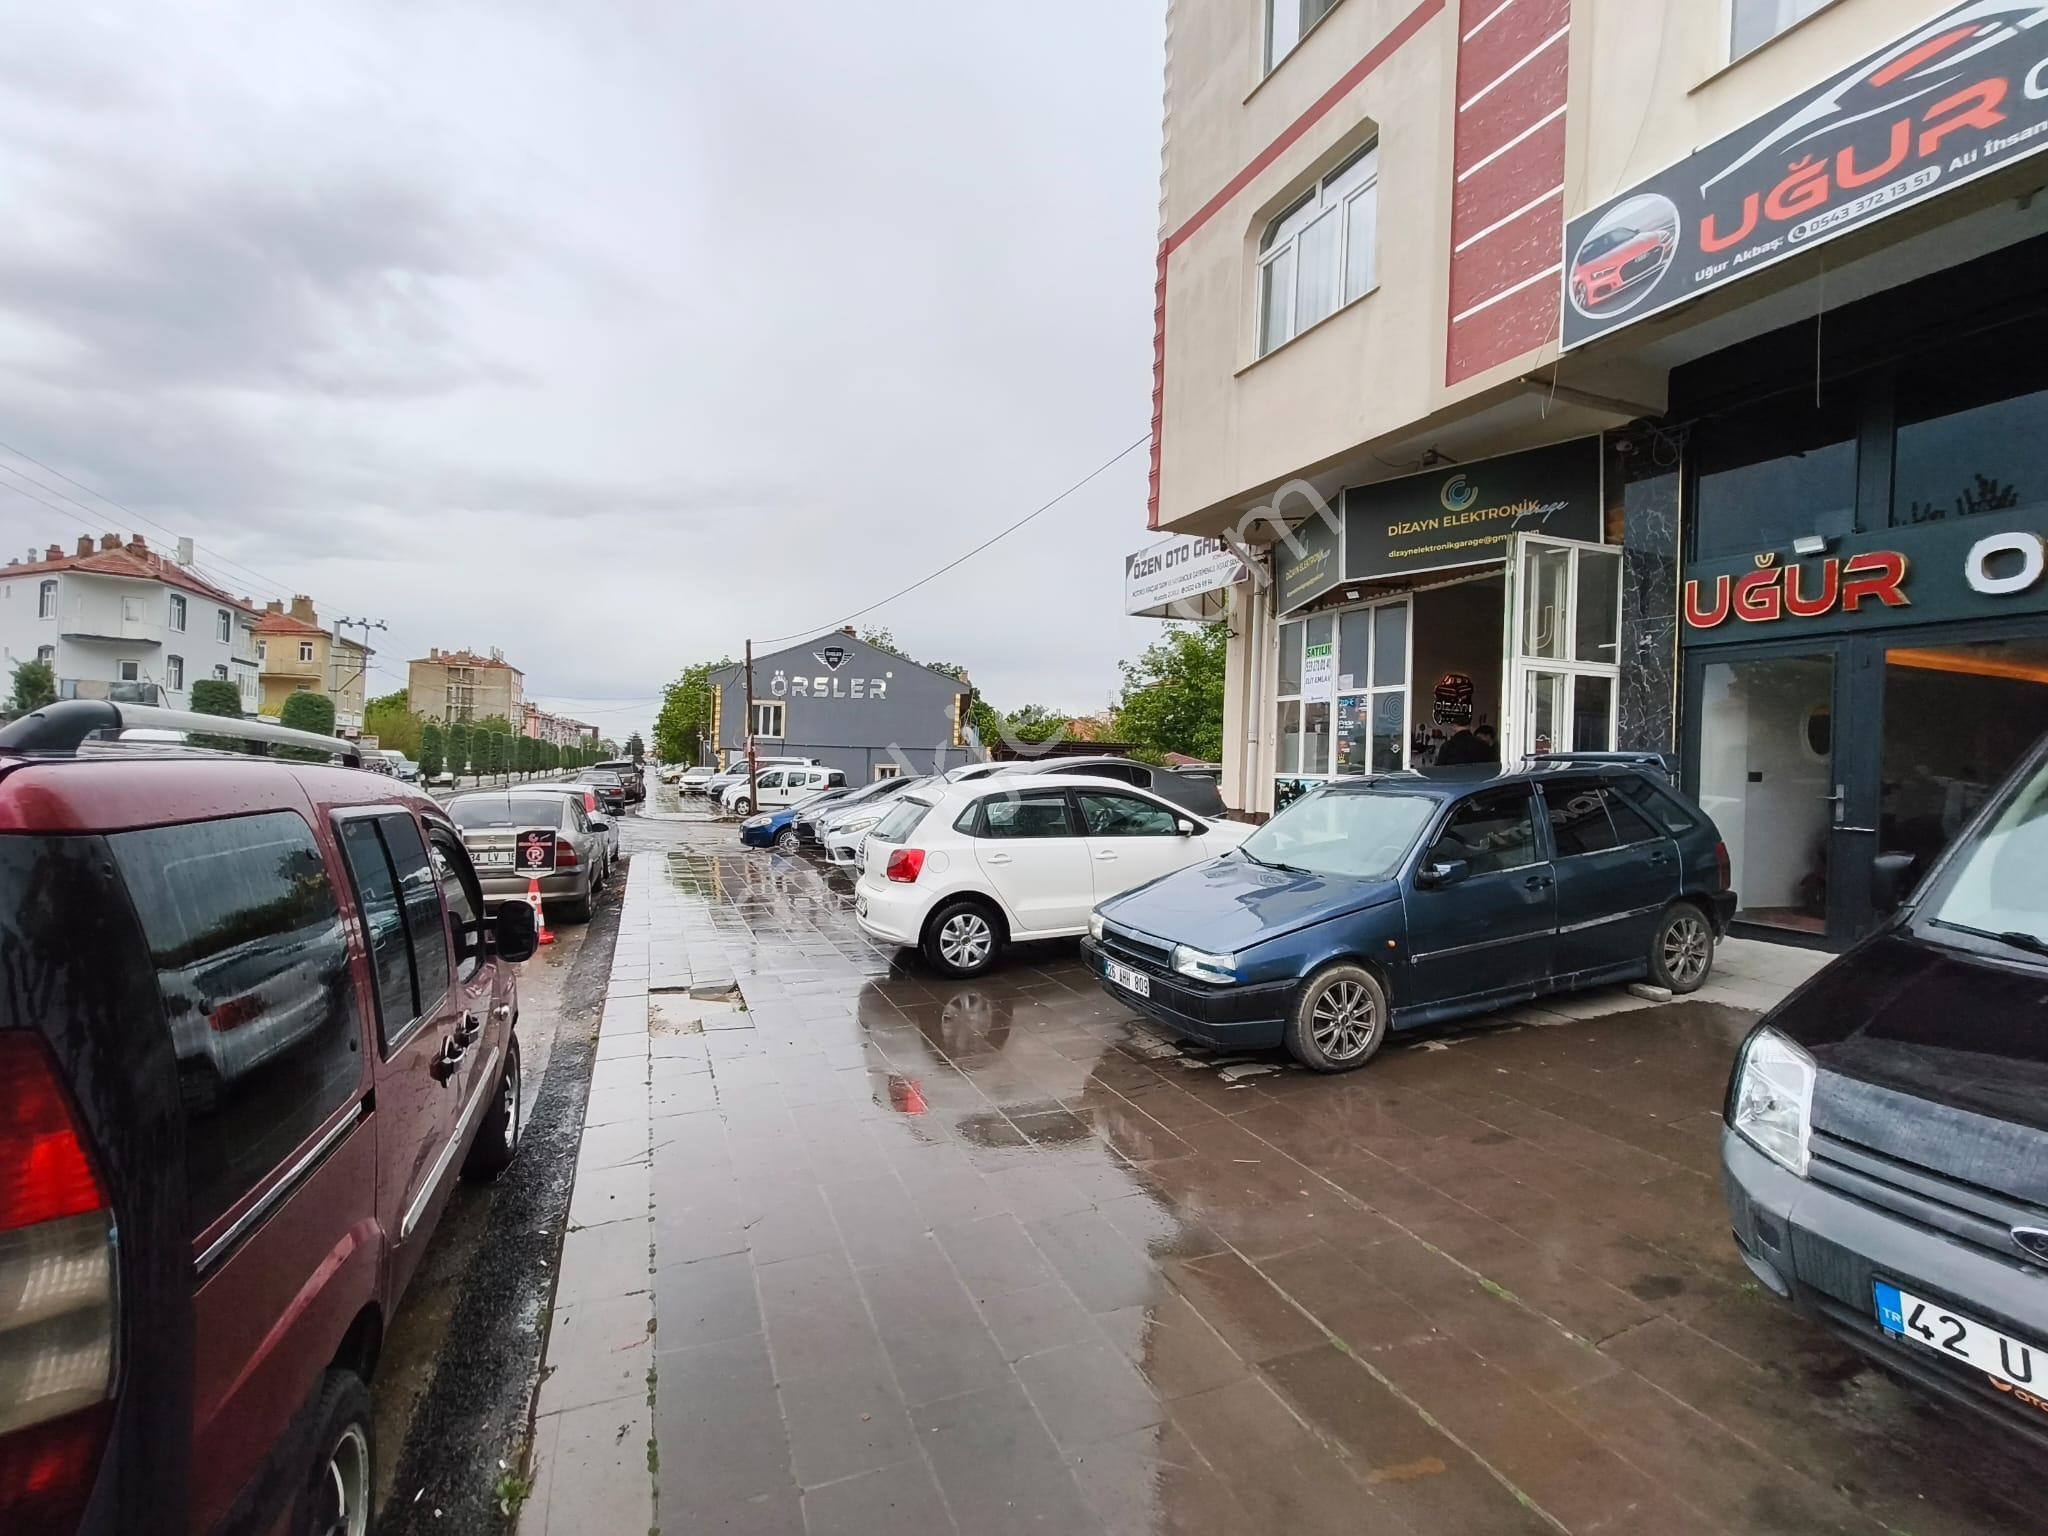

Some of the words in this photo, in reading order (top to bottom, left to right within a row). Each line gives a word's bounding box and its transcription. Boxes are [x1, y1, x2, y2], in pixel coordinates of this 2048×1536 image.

[1699, 76, 2008, 253] UĞUR
[1694, 260, 1729, 282] Uğur
[1809, 207, 1849, 231] 0543
[1855, 194, 1884, 212] 372
[1890, 183, 1908, 197] 13
[1913, 171, 1931, 188] 51
[1948, 149, 1978, 172] Ali
[1388, 519, 1439, 537] DİZAYN
[1443, 499, 1540, 527] ELEKTRONİK
[1133, 554, 1162, 580] ÖZEN
[1165, 544, 1190, 569] OTO
[1685, 550, 1912, 628] UĞUR
[770, 670, 887, 699] ÖRSLER
[1882, 1307, 1902, 1324] TR
[1908, 1304, 1970, 1358] 42
[2000, 1337, 2032, 1383] U
